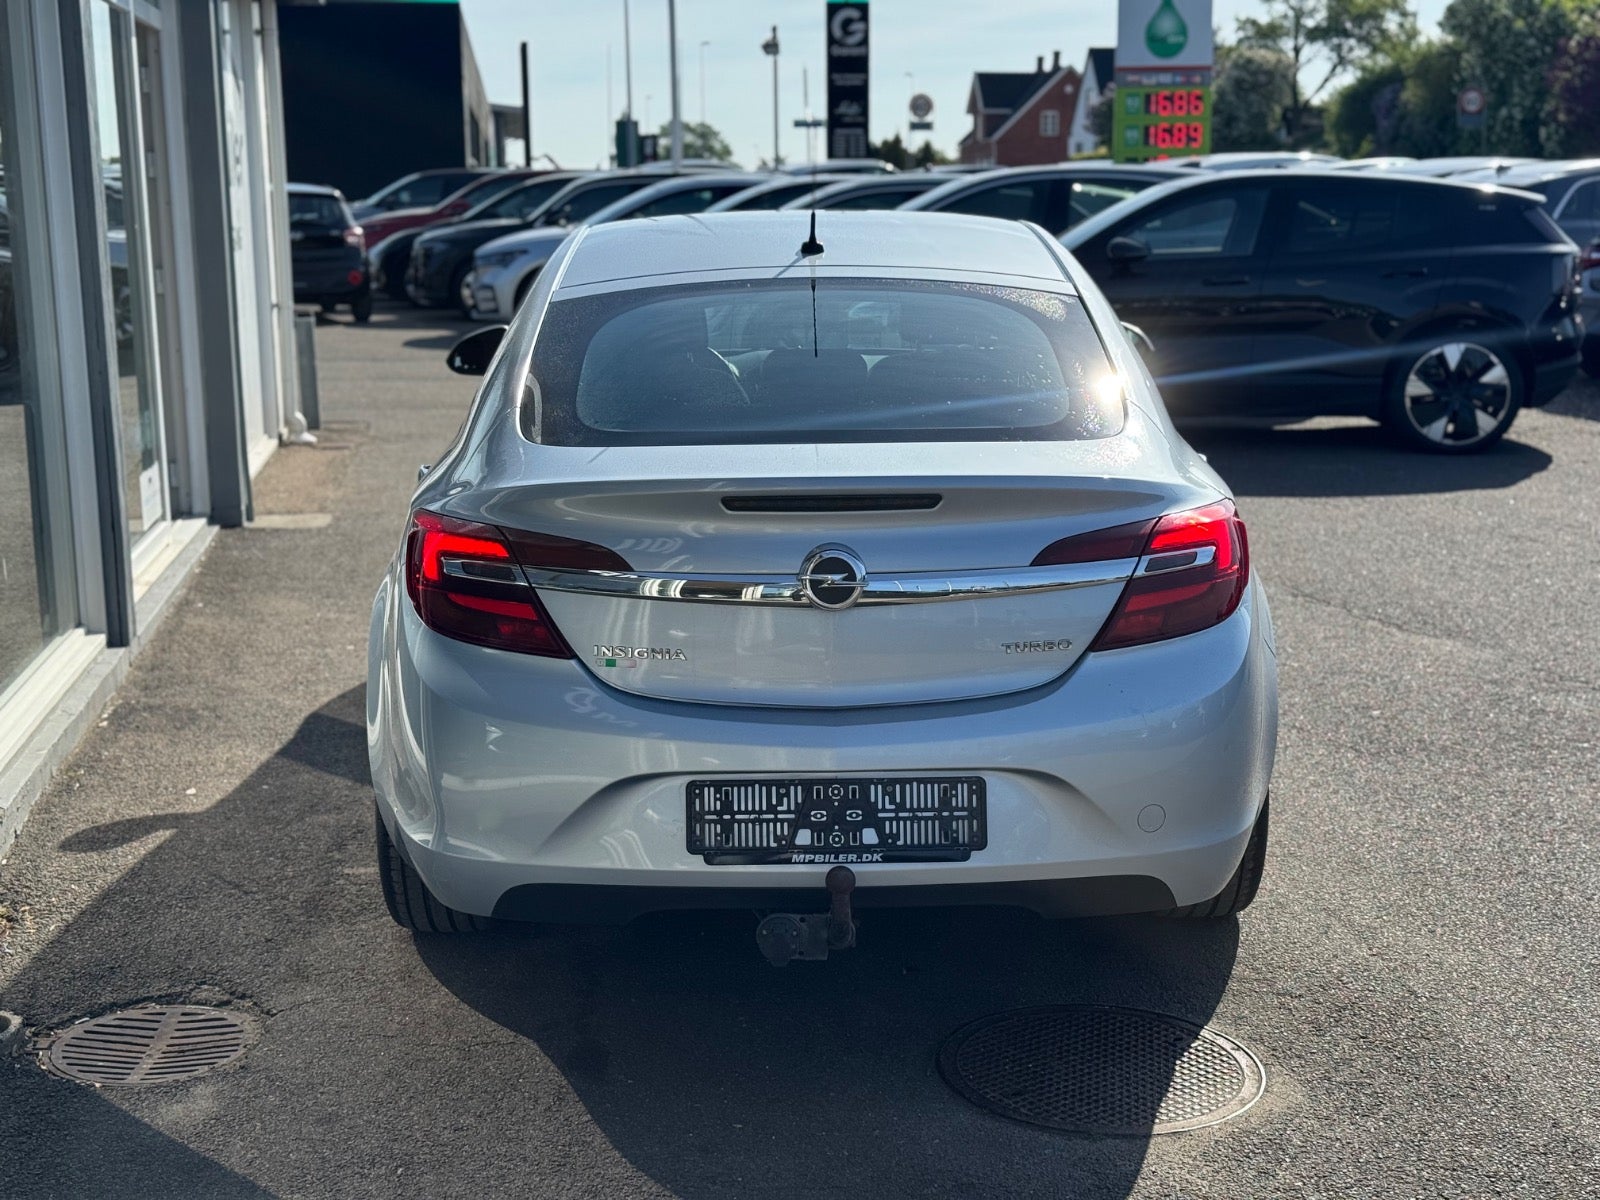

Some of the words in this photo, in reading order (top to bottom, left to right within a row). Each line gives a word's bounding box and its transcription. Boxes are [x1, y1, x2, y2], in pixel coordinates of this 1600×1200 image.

[593, 645, 687, 661] INSIGNIA
[1001, 639, 1072, 654] TURBO
[791, 852, 884, 863] MPBILER.DK
